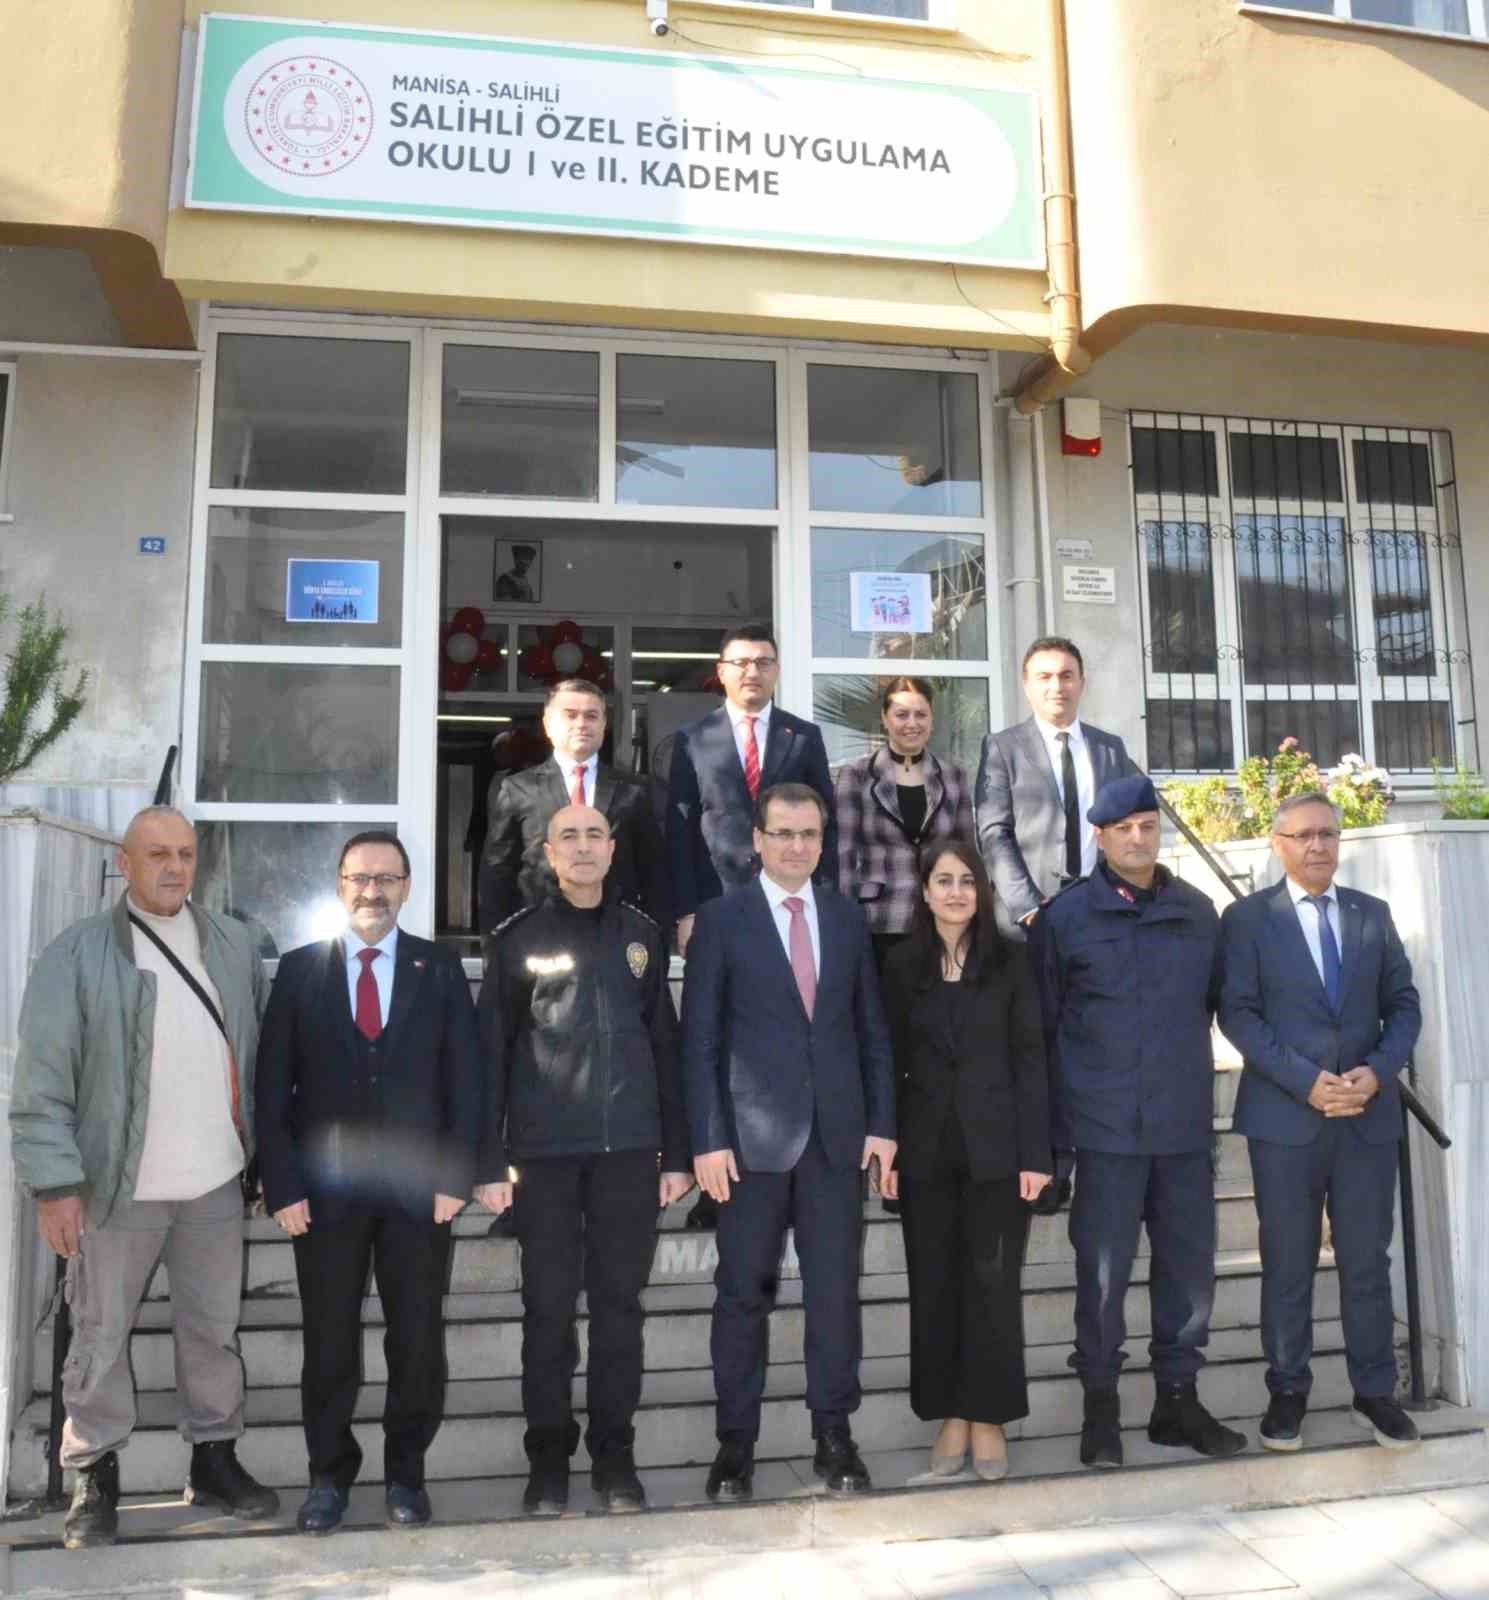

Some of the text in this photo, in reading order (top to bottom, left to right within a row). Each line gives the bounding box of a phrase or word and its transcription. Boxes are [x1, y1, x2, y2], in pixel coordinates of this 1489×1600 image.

[392, 73, 470, 97] MANİSA
[487, 81, 560, 103] SALİHLİ
[389, 99, 951, 174] SALİHLİ ÖZEL EĞİTİM UYGULAMA
[387, 140, 780, 195] OKULU I ve II. KADEME
[143, 540, 161, 550] 42
